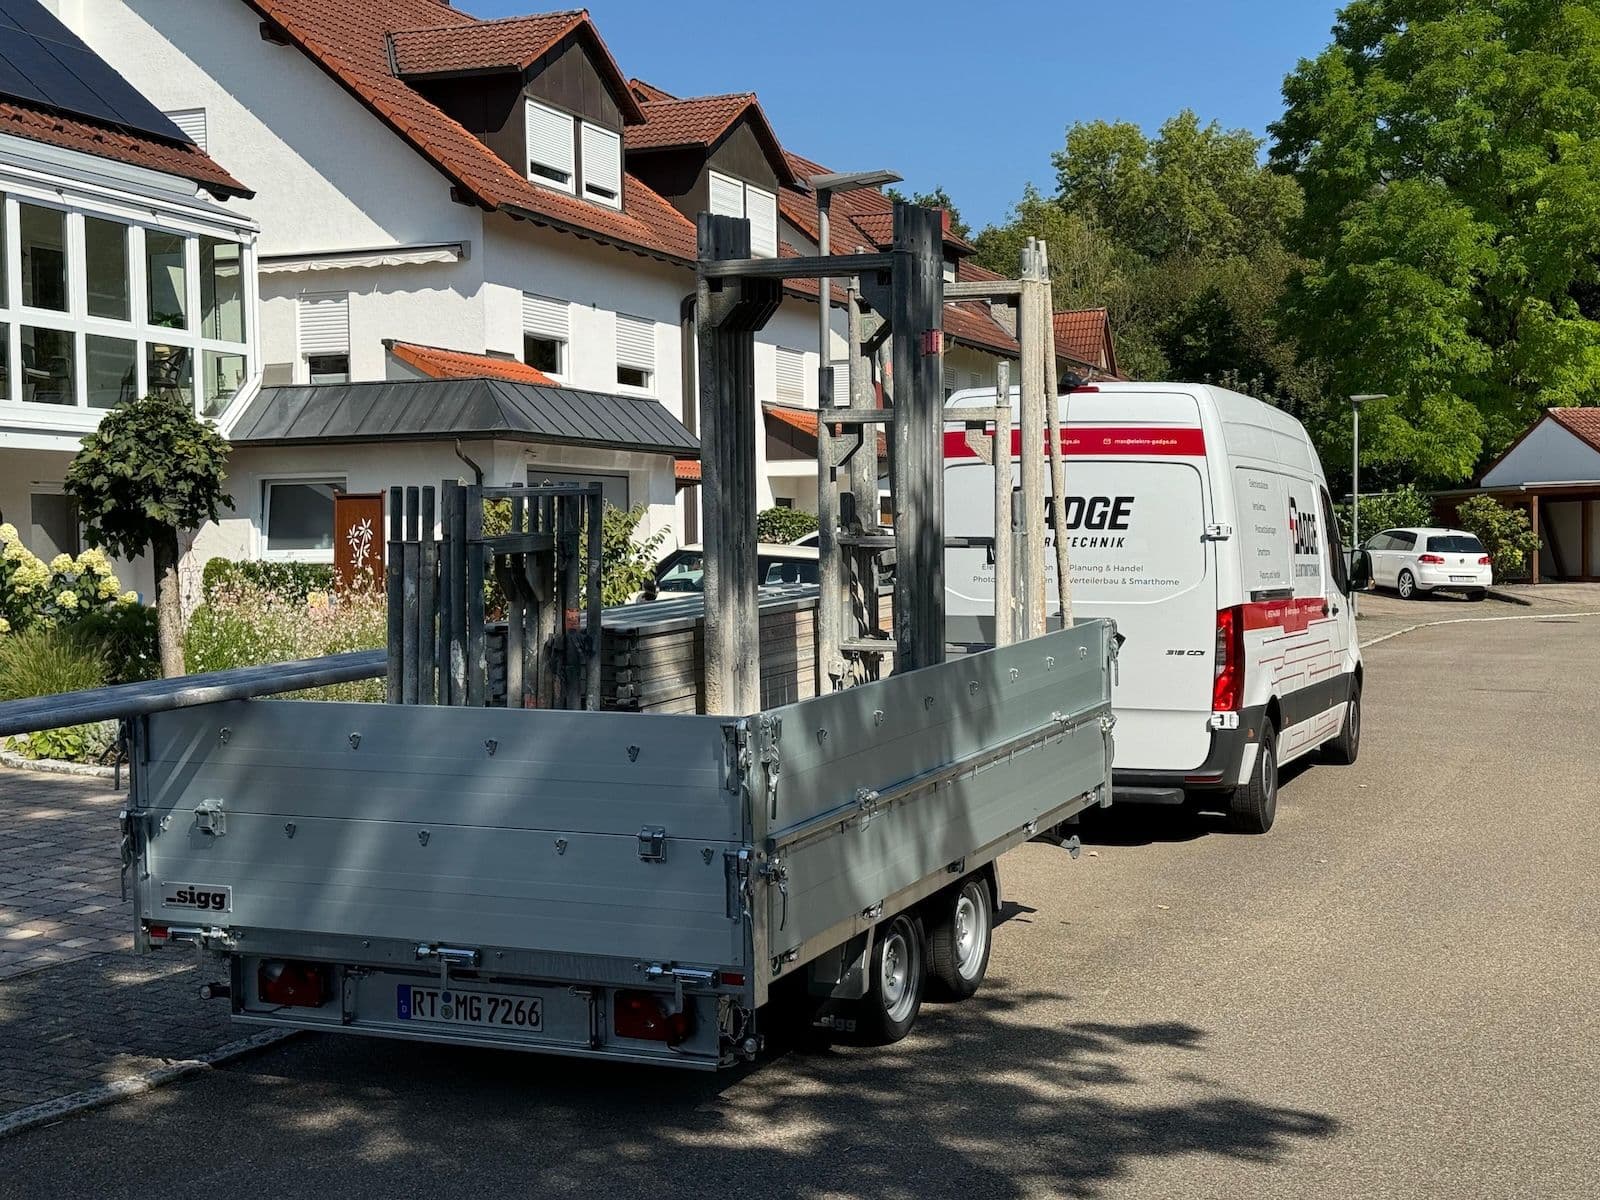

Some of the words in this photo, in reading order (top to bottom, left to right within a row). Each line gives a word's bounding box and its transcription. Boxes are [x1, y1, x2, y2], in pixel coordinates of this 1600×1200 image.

[1044, 496, 1136, 530] ADGE
[1069, 565, 1103, 573] Planung
[1129, 578, 1180, 586] Smarthome
[412, 990, 439, 1017] RT
[455, 993, 482, 1022] MG
[487, 997, 541, 1027] 7266
